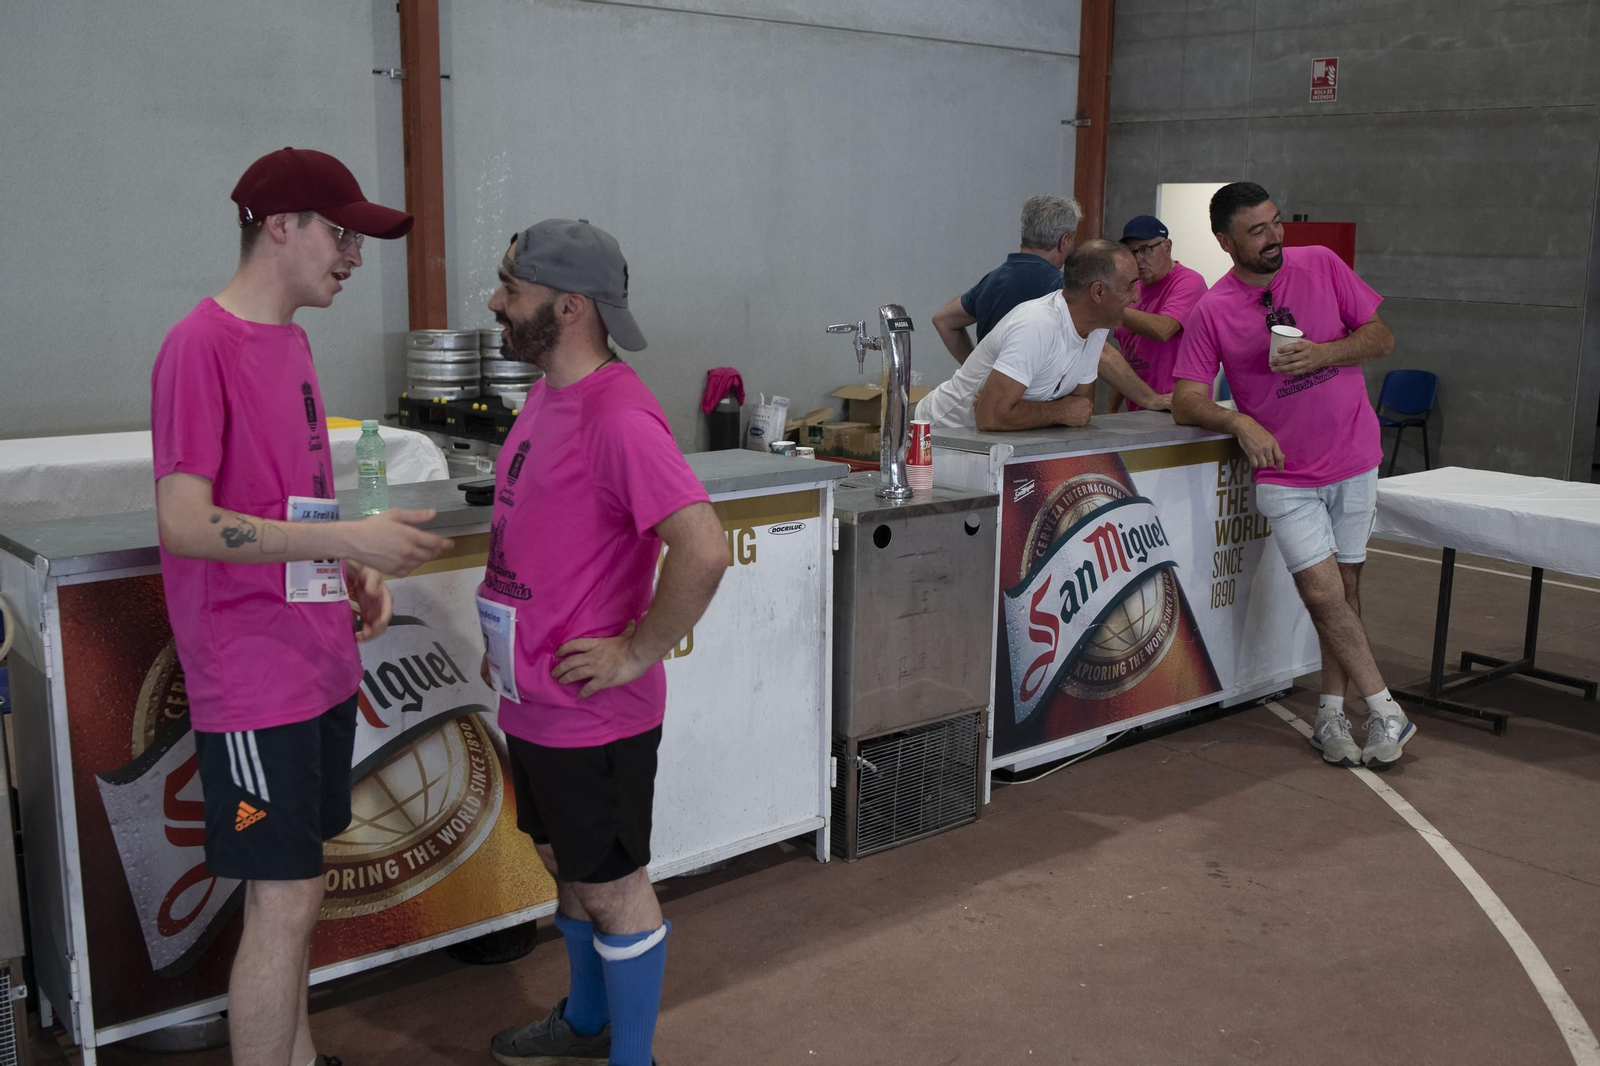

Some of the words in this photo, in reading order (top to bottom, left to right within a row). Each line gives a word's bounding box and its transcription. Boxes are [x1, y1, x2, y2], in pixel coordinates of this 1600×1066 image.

[1216, 487, 1250, 517] THE
[1036, 504, 1065, 557] CERVEZA
[1212, 547, 1244, 579] SINCE
[1163, 572, 1172, 594] 1890
[1210, 579, 1236, 610] 1890
[1019, 559, 1098, 702] San
[1083, 516, 1170, 582] Miguel
[1163, 595, 1174, 624] SINCE
[1144, 623, 1168, 656] WORLD
[1073, 661, 1127, 681] XPLORING
[1128, 650, 1147, 671] THE
[358, 641, 469, 729] iguel
[460, 722, 484, 754] 1890
[470, 755, 487, 796] SINCE
[235, 810, 267, 831] adidas
[436, 795, 482, 846] WORLD
[403, 838, 439, 871] THE
[325, 859, 400, 892] ORING
